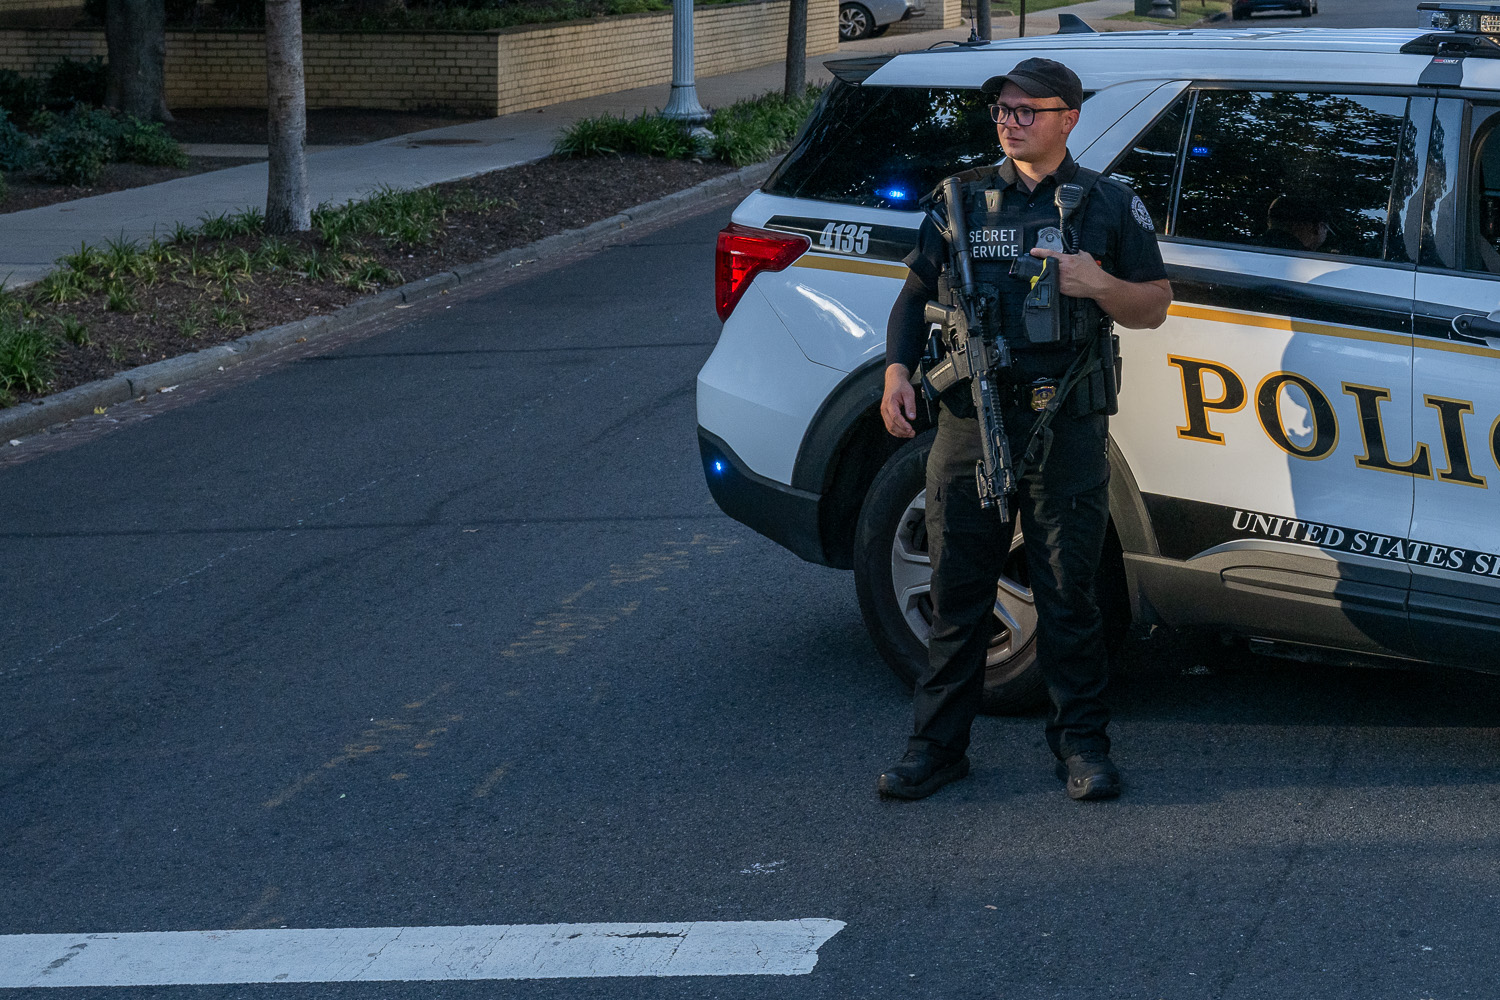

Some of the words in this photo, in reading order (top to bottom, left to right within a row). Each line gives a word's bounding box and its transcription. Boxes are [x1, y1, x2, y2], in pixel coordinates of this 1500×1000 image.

[819, 222, 873, 255] 4135
[969, 229, 1017, 243] SECRET
[970, 244, 1019, 258] ERVICE
[1231, 510, 1345, 547] UNITED
[1350, 532, 1466, 569] STATES
